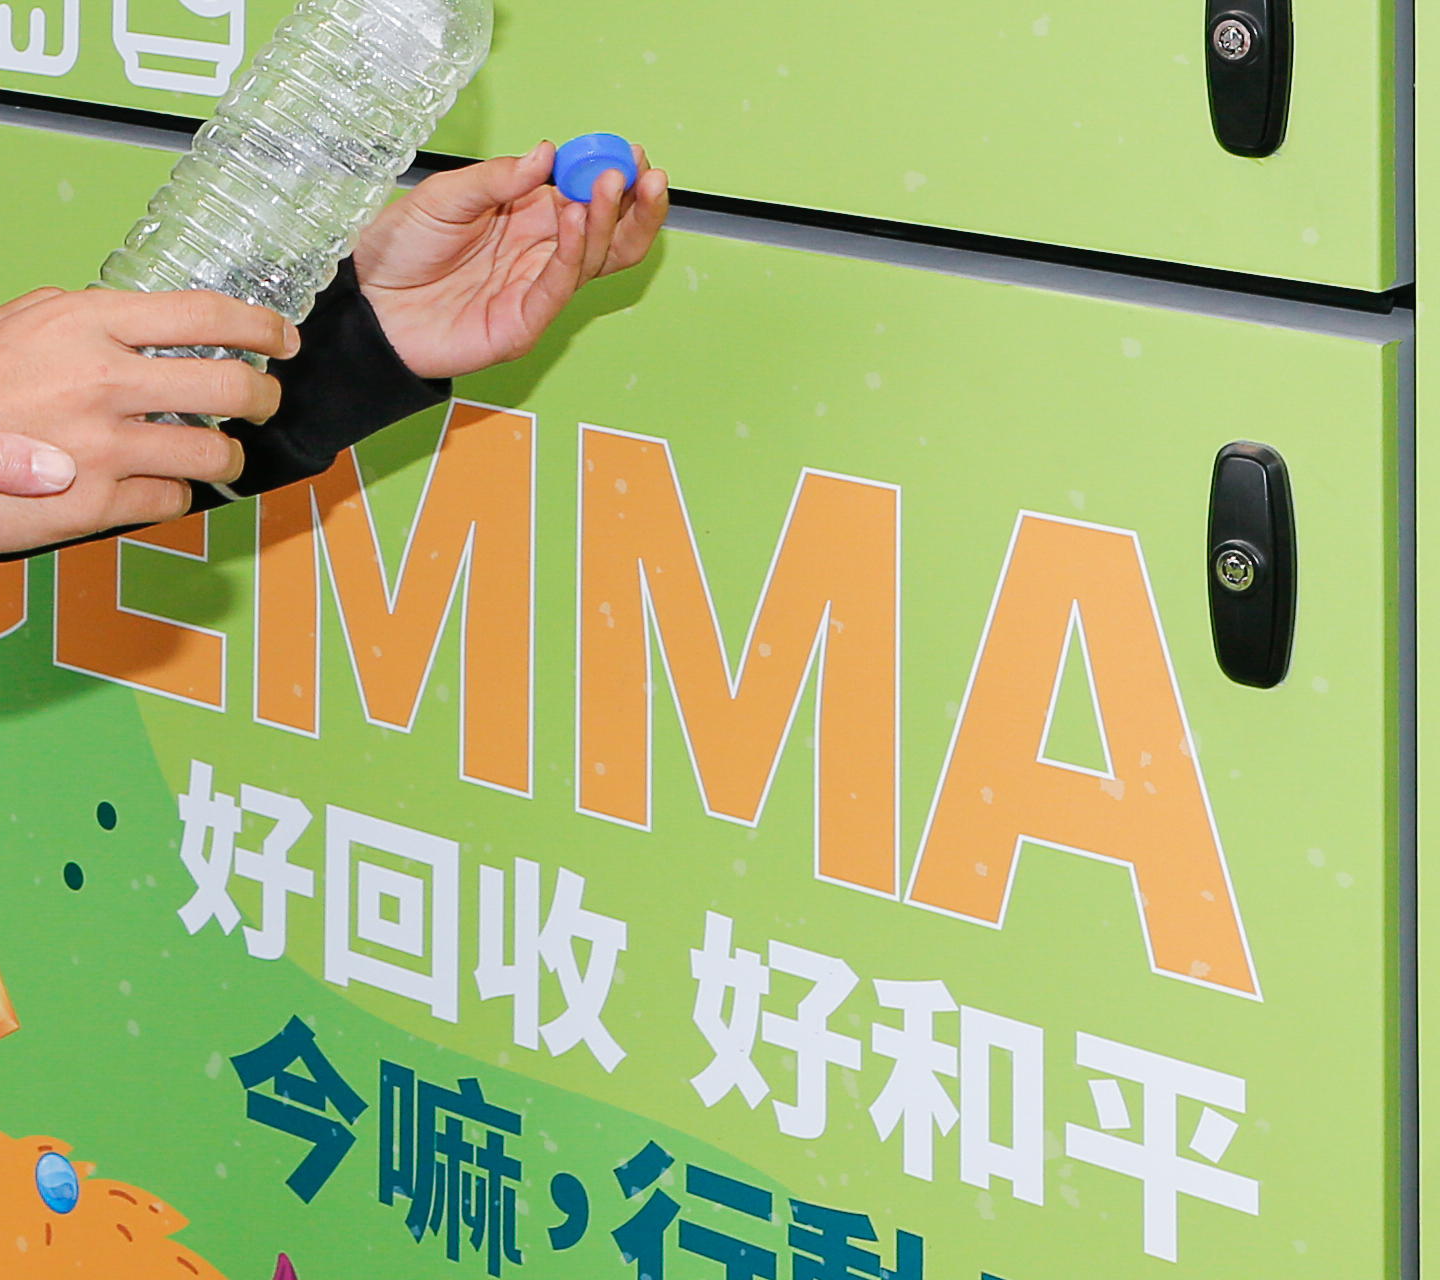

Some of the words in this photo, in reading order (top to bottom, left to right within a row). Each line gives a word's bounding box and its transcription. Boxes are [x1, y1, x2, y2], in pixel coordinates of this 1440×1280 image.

[178, 758, 628, 1076] 好回收
[689, 910, 1262, 1263] 好和平
